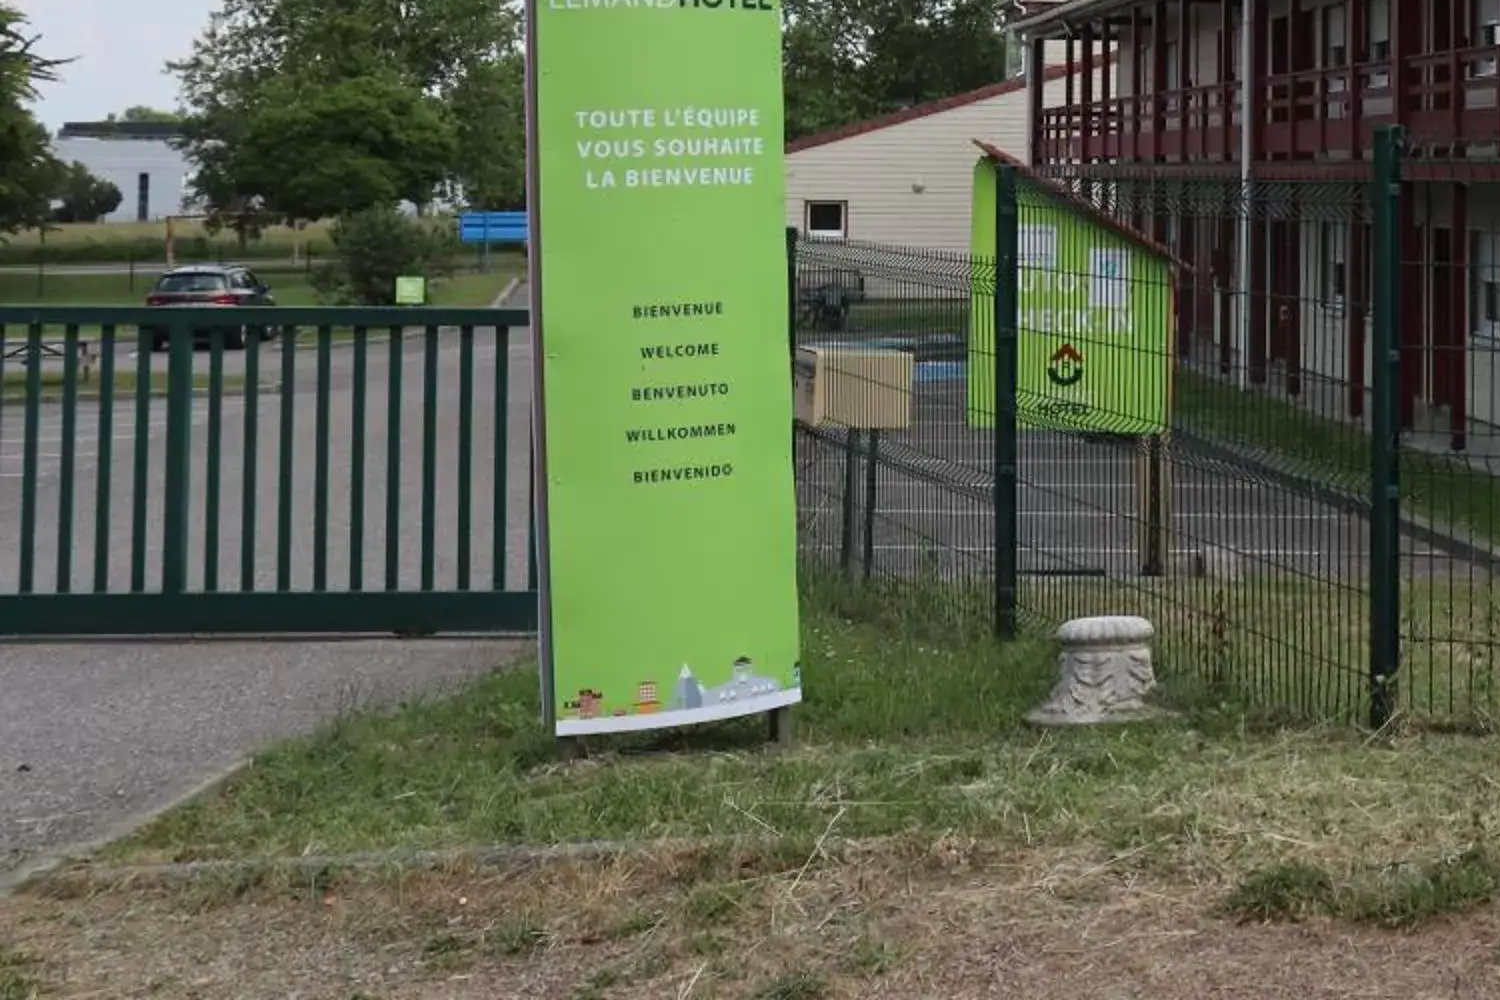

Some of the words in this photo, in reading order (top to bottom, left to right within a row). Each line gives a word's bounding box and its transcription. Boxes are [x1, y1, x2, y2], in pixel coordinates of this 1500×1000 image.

[576, 109, 655, 128] TOUTE
[664, 104, 760, 128] L'ÉQUIPE
[577, 139, 645, 158] VOUS
[654, 137, 764, 157] SOUHAITE
[586, 169, 615, 188] LA
[625, 167, 754, 187] BIENVENUE
[1017, 270, 1080, 293] UTO
[633, 301, 723, 319] BIENVENUE
[640, 343, 719, 358] WELCOME
[631, 383, 729, 401] BENVENUTO
[625, 423, 736, 442] WILLKOMMEN
[633, 463, 733, 483] BIENVENIDO
